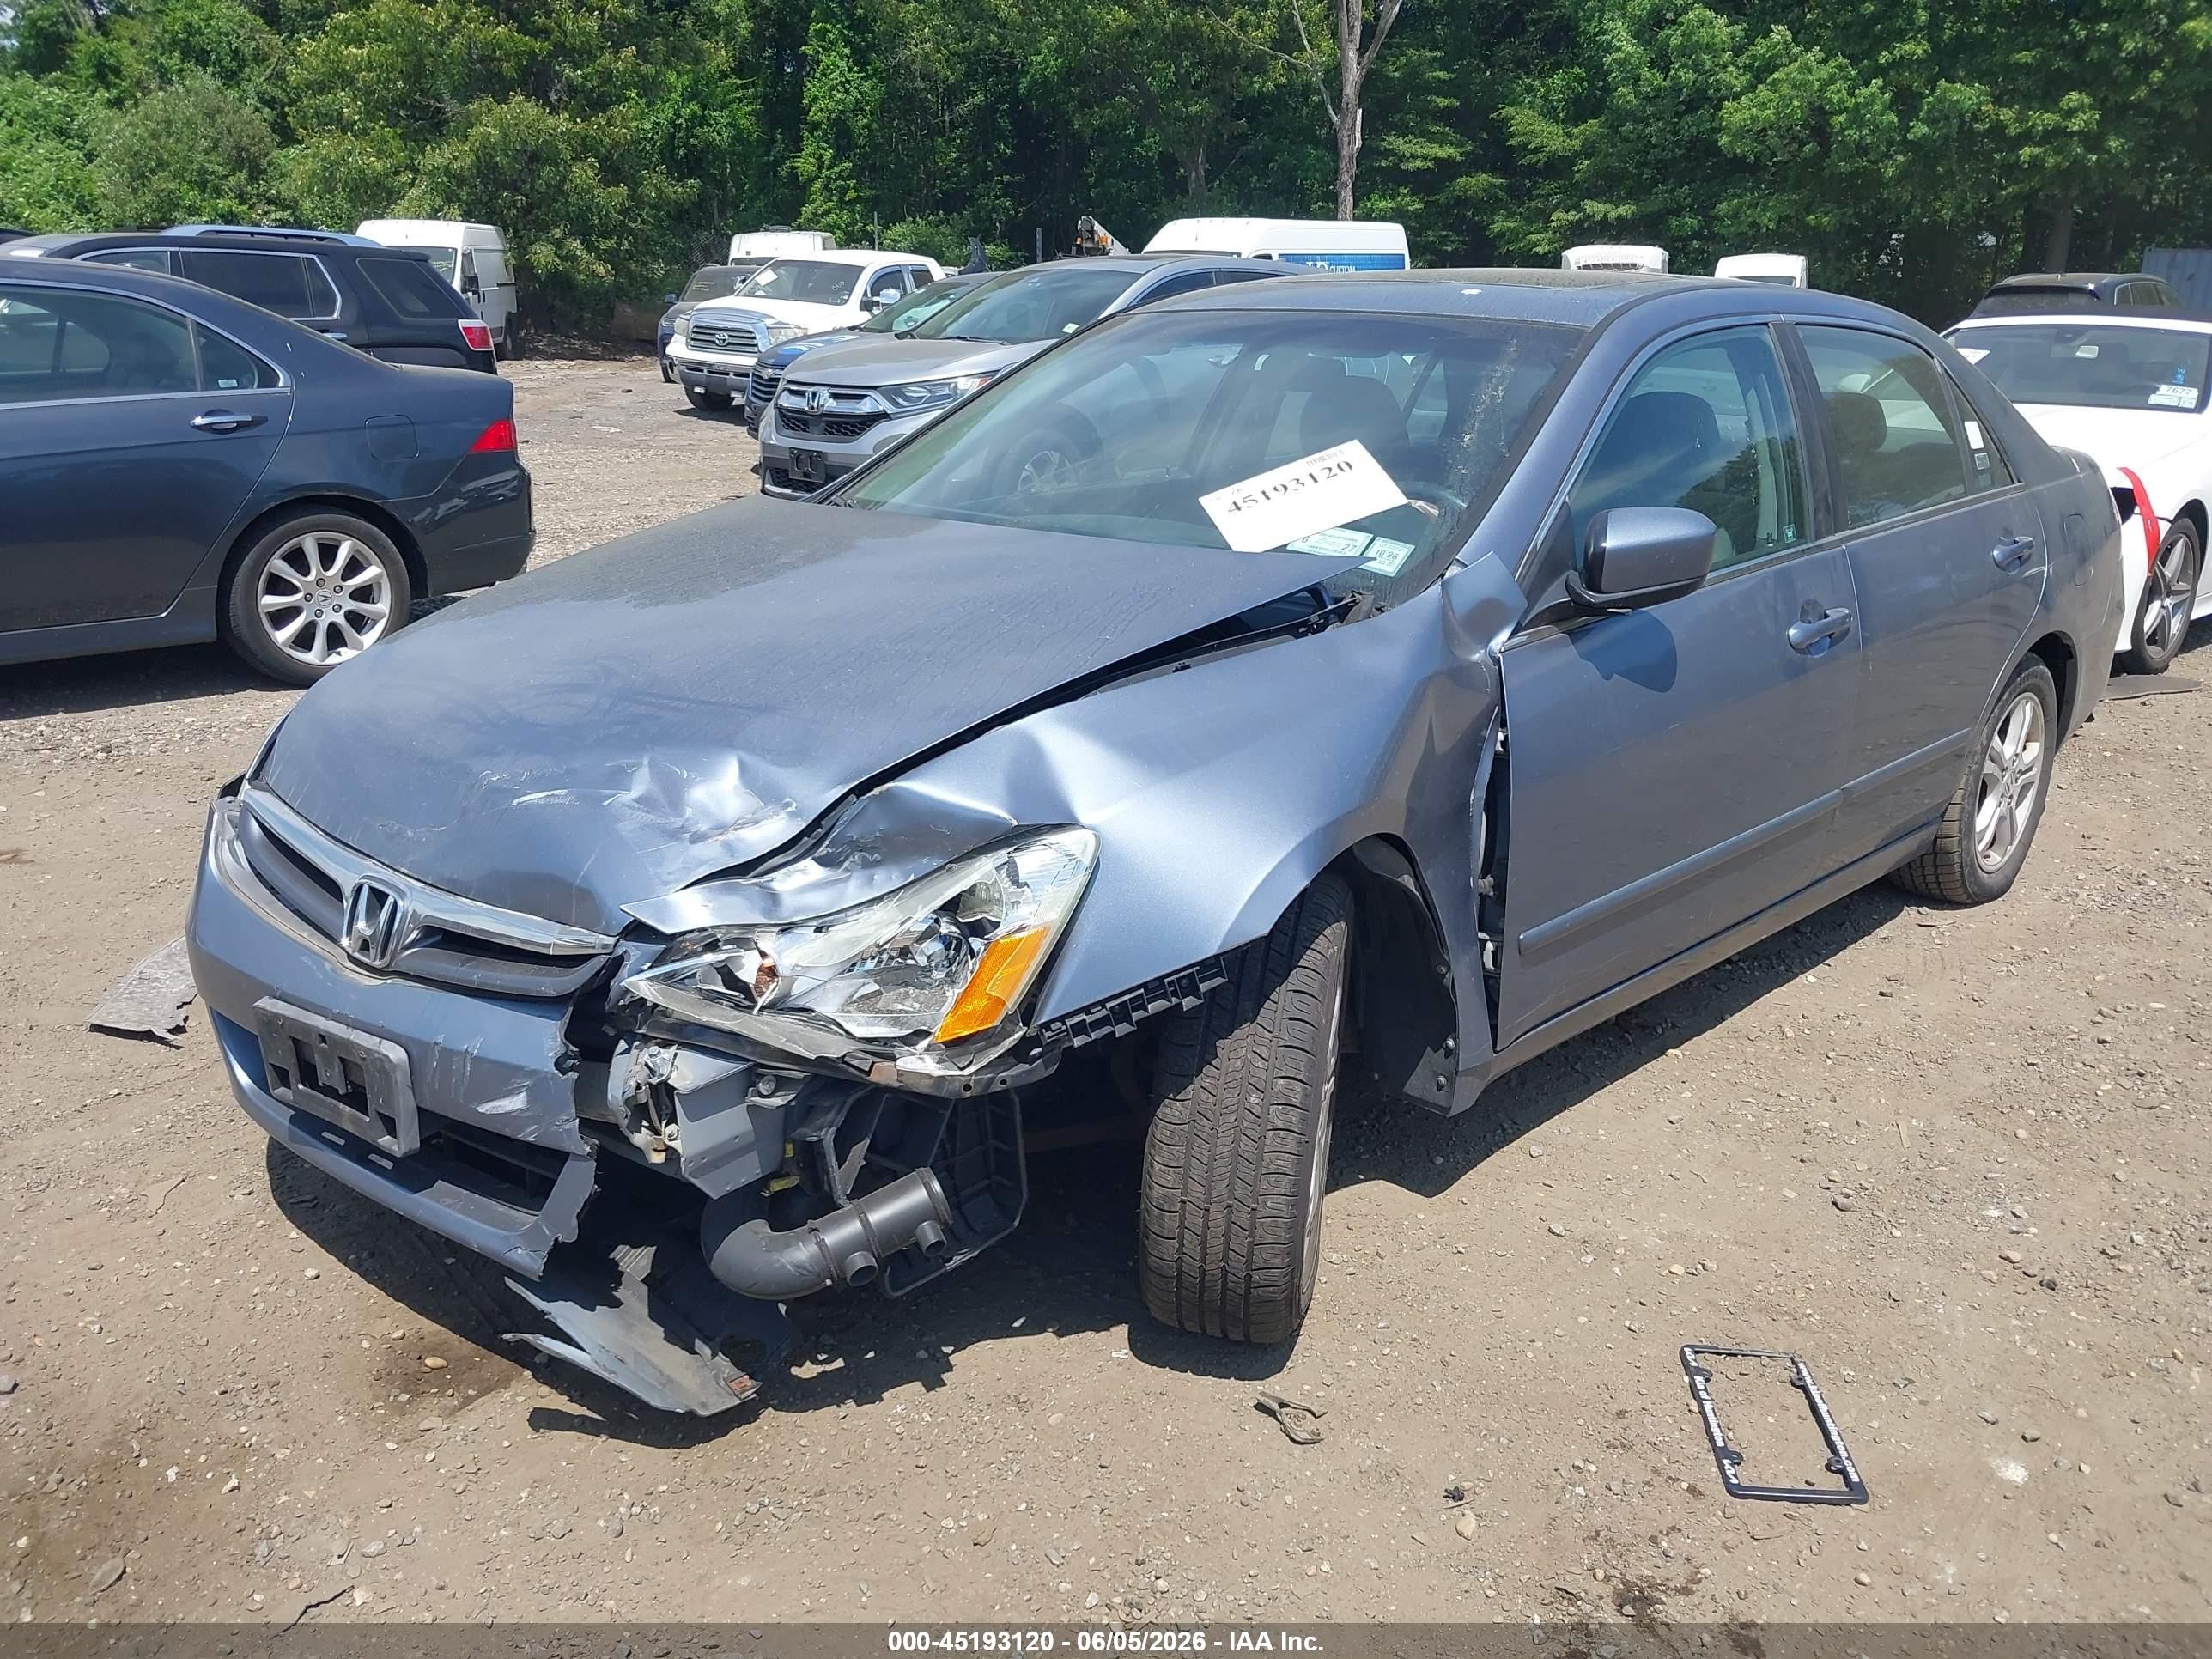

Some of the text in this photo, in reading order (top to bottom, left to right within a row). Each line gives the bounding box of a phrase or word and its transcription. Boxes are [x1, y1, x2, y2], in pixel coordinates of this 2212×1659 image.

[1228, 460, 1353, 513] 45193120
[1703, 1401, 1725, 1447] Huntington
[1798, 1362, 1861, 1483] www.kiaofhuntington.com
